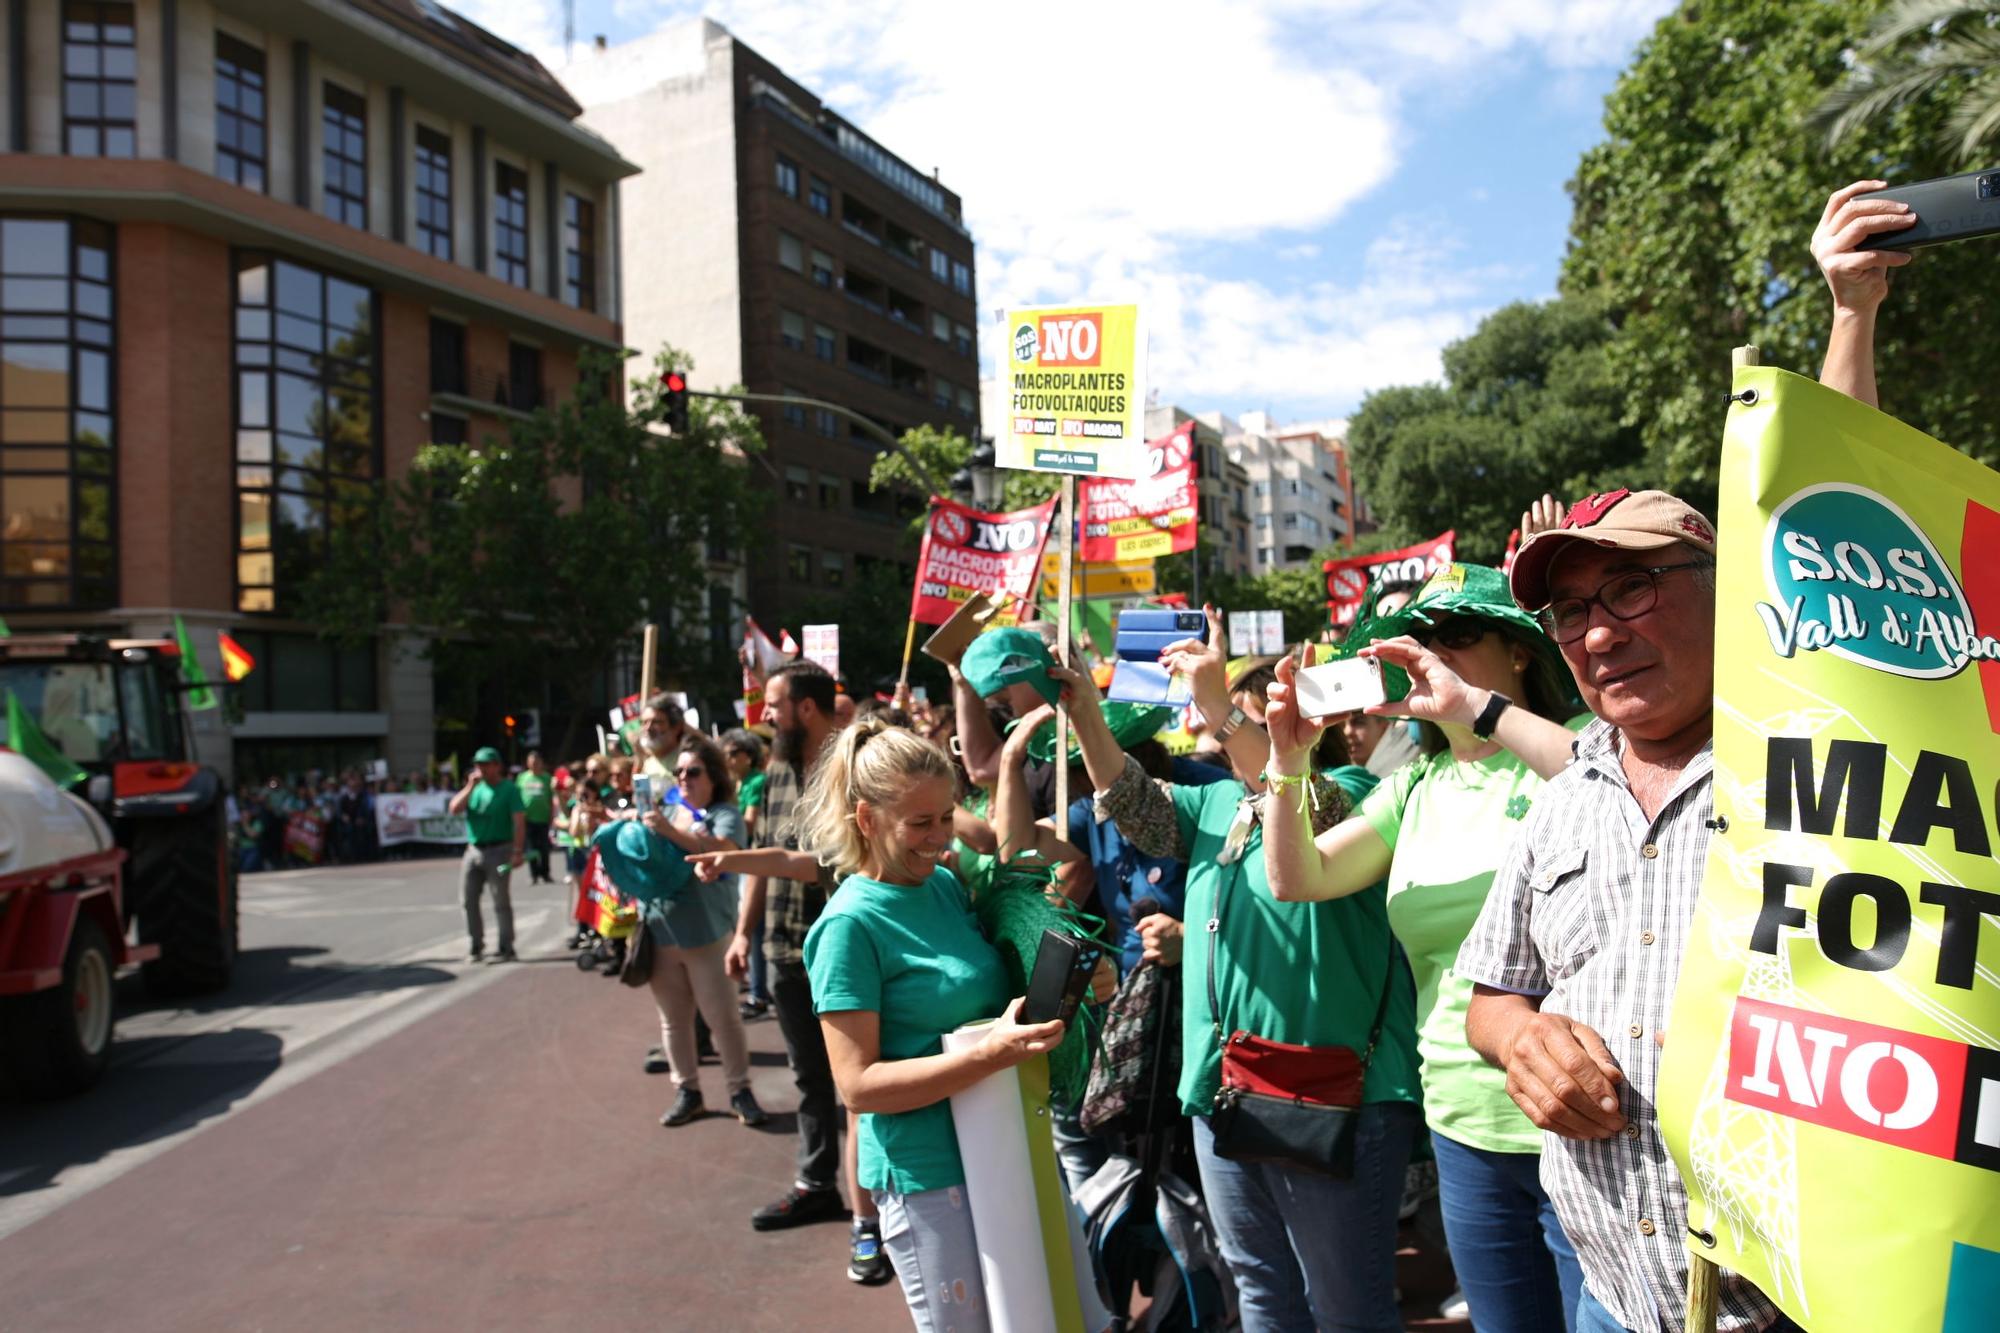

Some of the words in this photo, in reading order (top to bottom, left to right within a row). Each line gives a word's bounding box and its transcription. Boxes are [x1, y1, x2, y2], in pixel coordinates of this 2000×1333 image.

[1041, 320, 1098, 361] NO
[1014, 373, 1125, 391] MACROPLANTES
[1013, 394, 1125, 415] FOTOVOLTAIQUES
[1015, 420, 1033, 433] NO
[1063, 420, 1083, 435] NO
[974, 520, 1036, 552] NO
[1782, 531, 1952, 599] S.O.S.
[921, 582, 947, 597] NO
[1755, 593, 1868, 659] Vall
[1764, 736, 2000, 859] MA
[1740, 1015, 1939, 1130] NO
